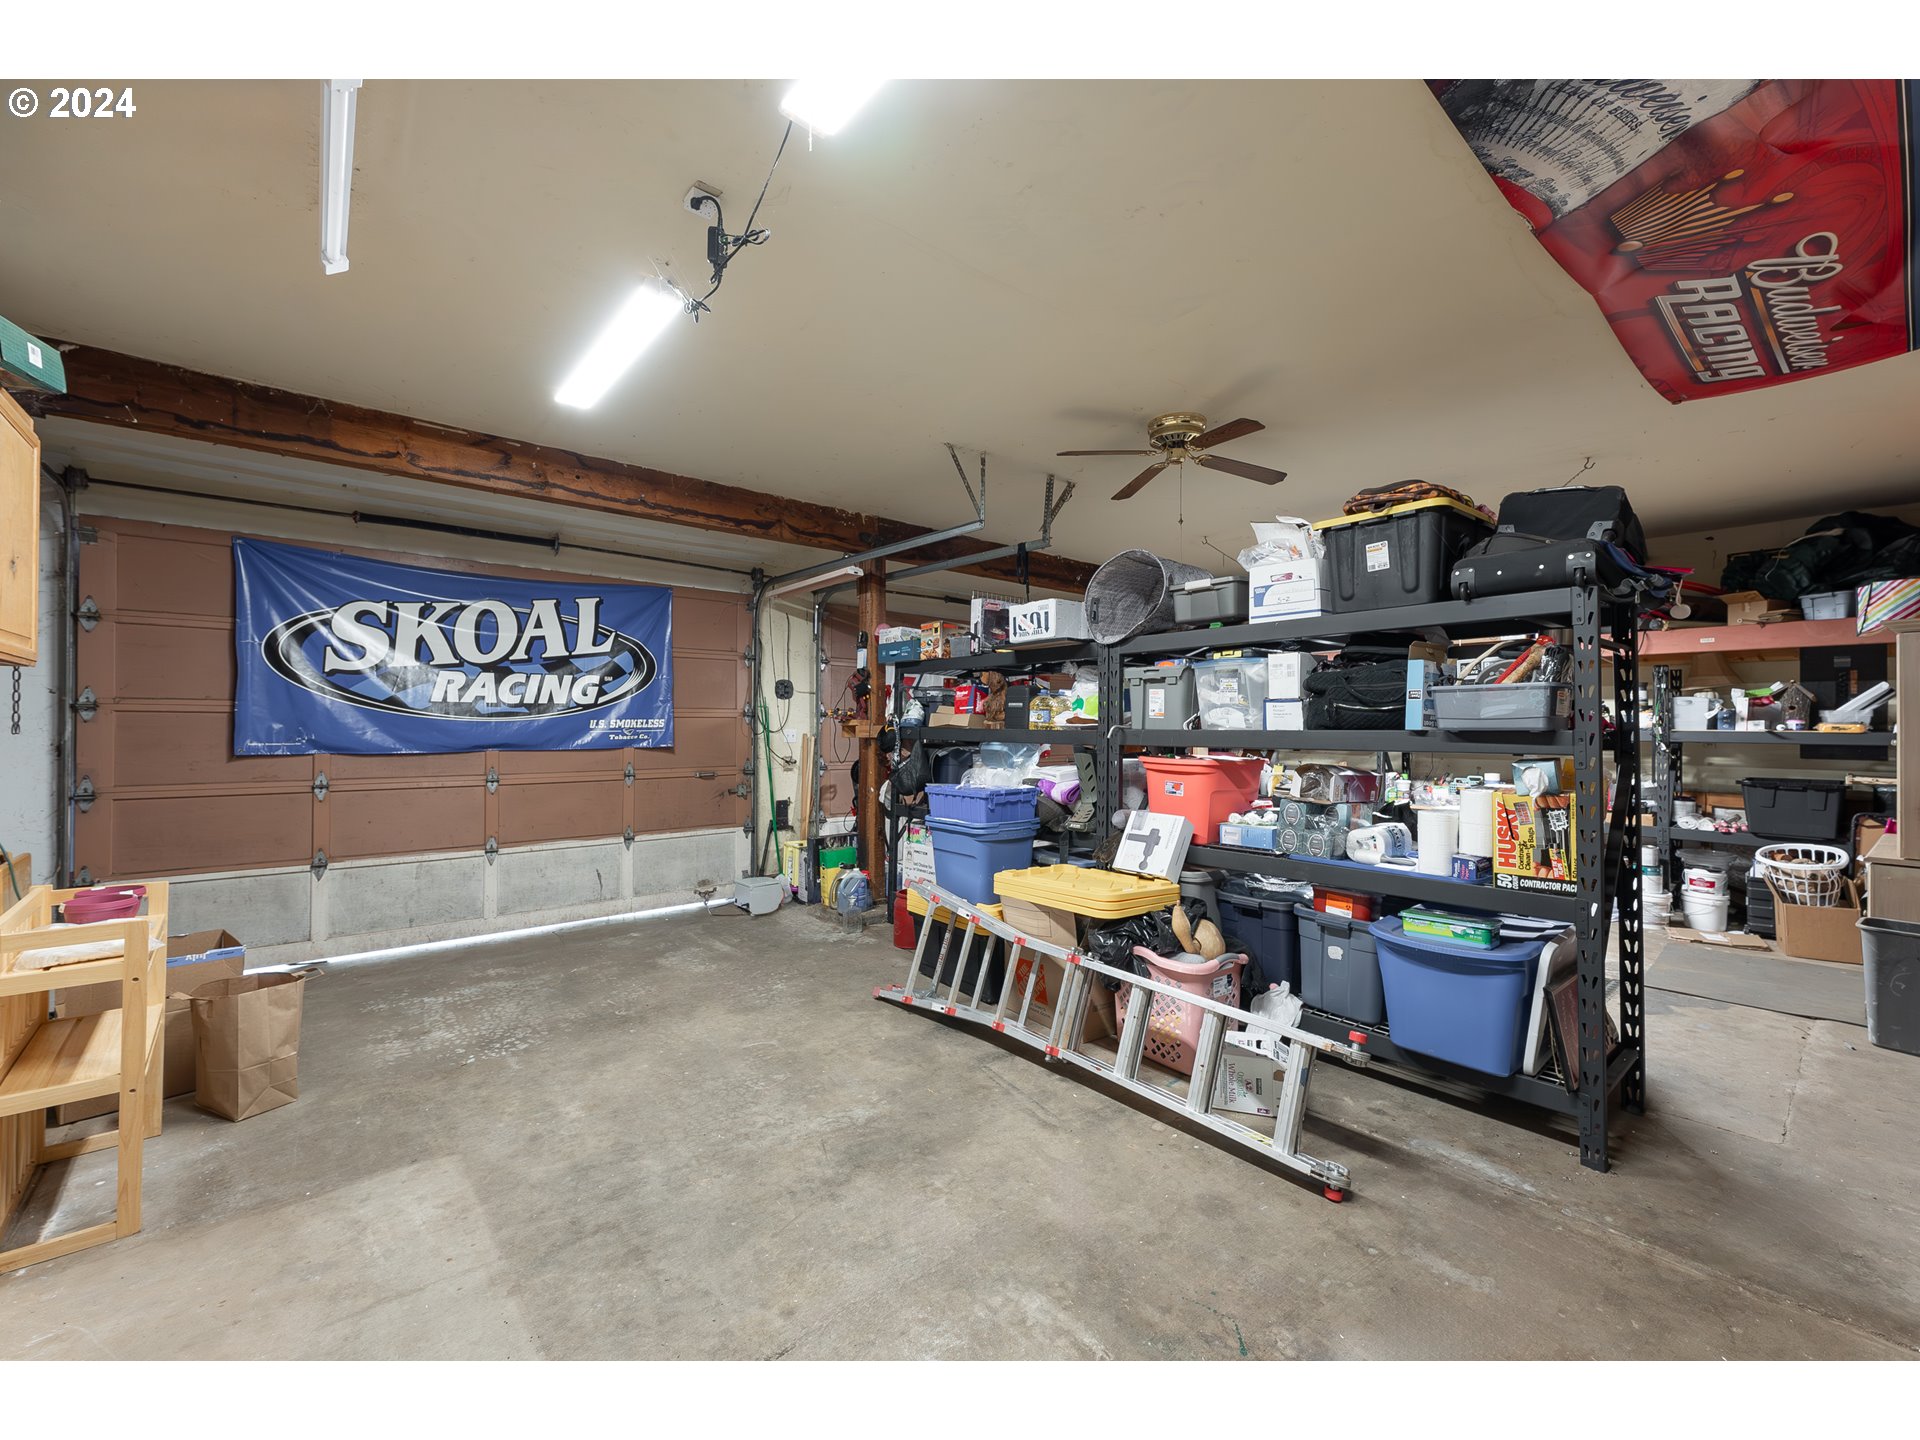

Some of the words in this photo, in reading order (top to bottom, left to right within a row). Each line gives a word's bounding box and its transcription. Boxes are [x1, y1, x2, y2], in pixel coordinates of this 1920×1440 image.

[1607, 105, 1644, 131] BEERS
[1747, 231, 1843, 371] Budweiser
[323, 596, 616, 674] SKOAL
[430, 671, 602, 706] RACING
[589, 719, 607, 729] U.S.
[609, 718, 665, 729] SMOKELESS
[1496, 799, 1520, 869] HUSKY
[1497, 873, 1512, 889] 50
[1519, 878, 1561, 892] CONTRACTOR
[1228, 1063, 1236, 1087] Whole
[1228, 1086, 1237, 1104] Milk
